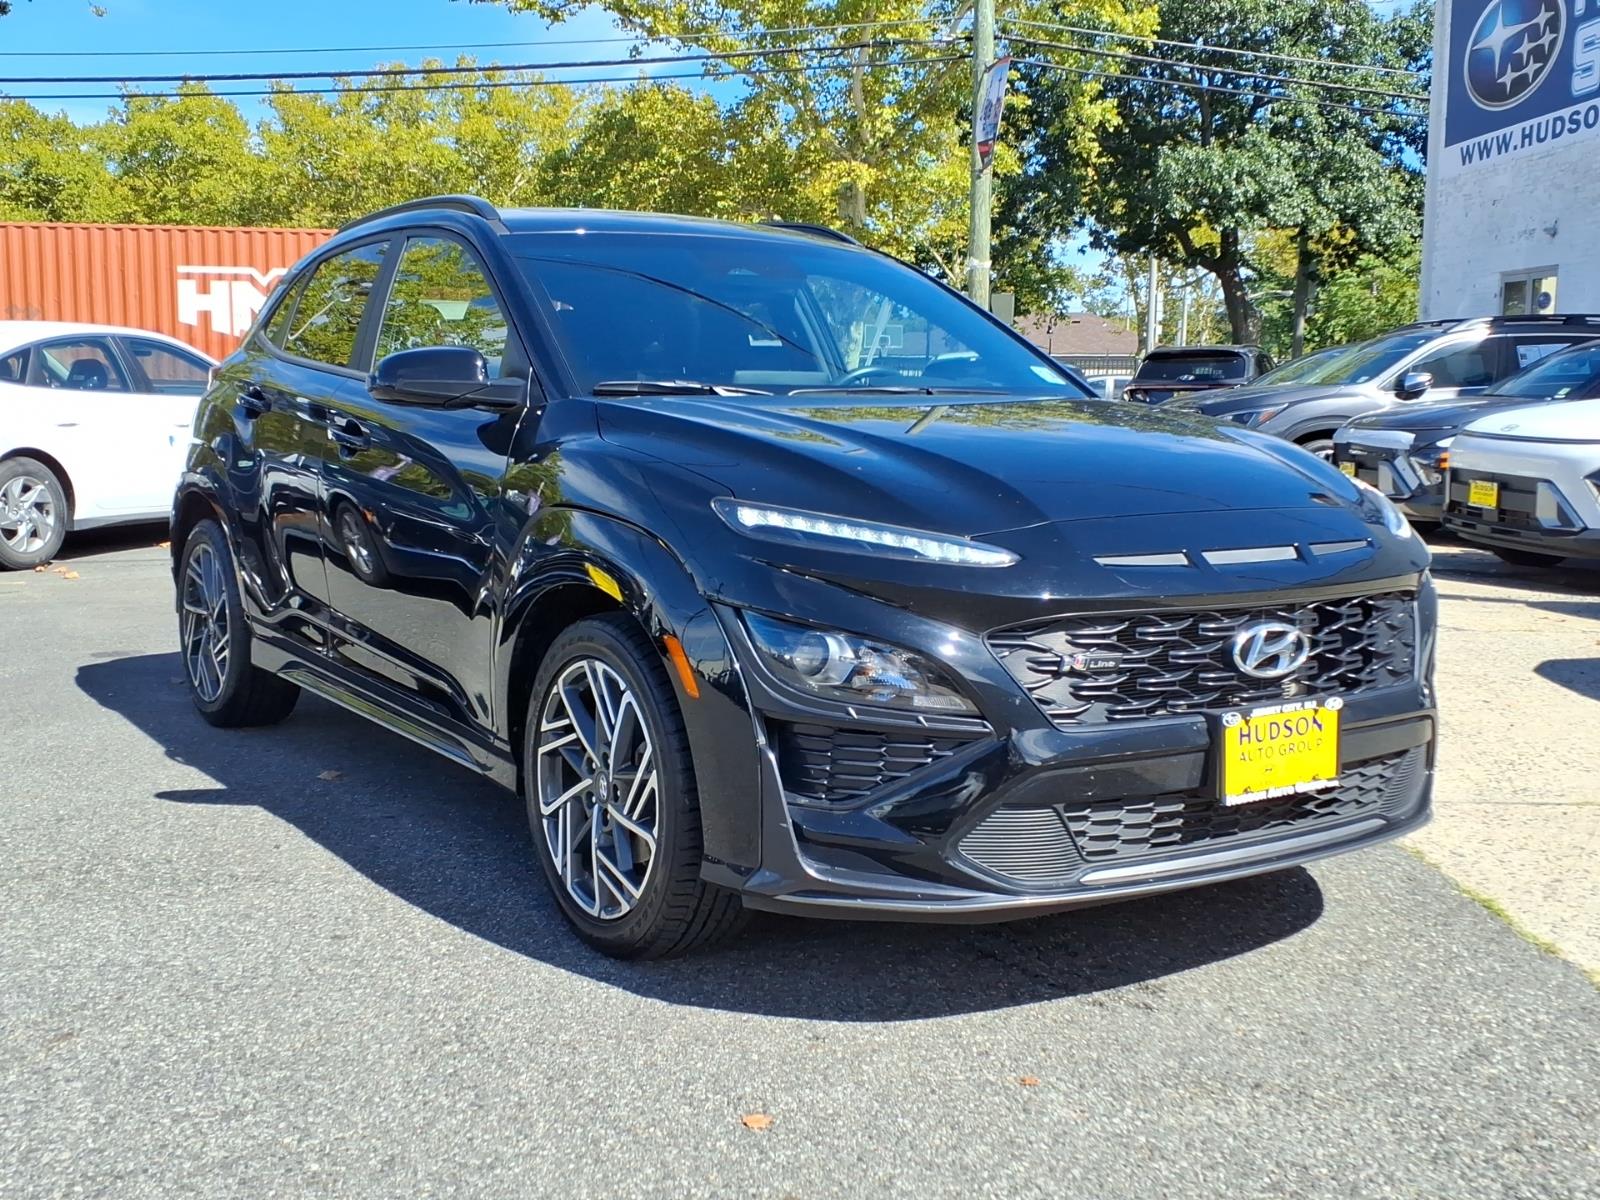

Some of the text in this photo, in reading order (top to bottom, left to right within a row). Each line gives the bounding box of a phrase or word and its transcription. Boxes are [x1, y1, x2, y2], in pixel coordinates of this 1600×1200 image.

[1239, 716, 1323, 746] HUDSON
[1240, 738, 1323, 762] AUTO GROUP
